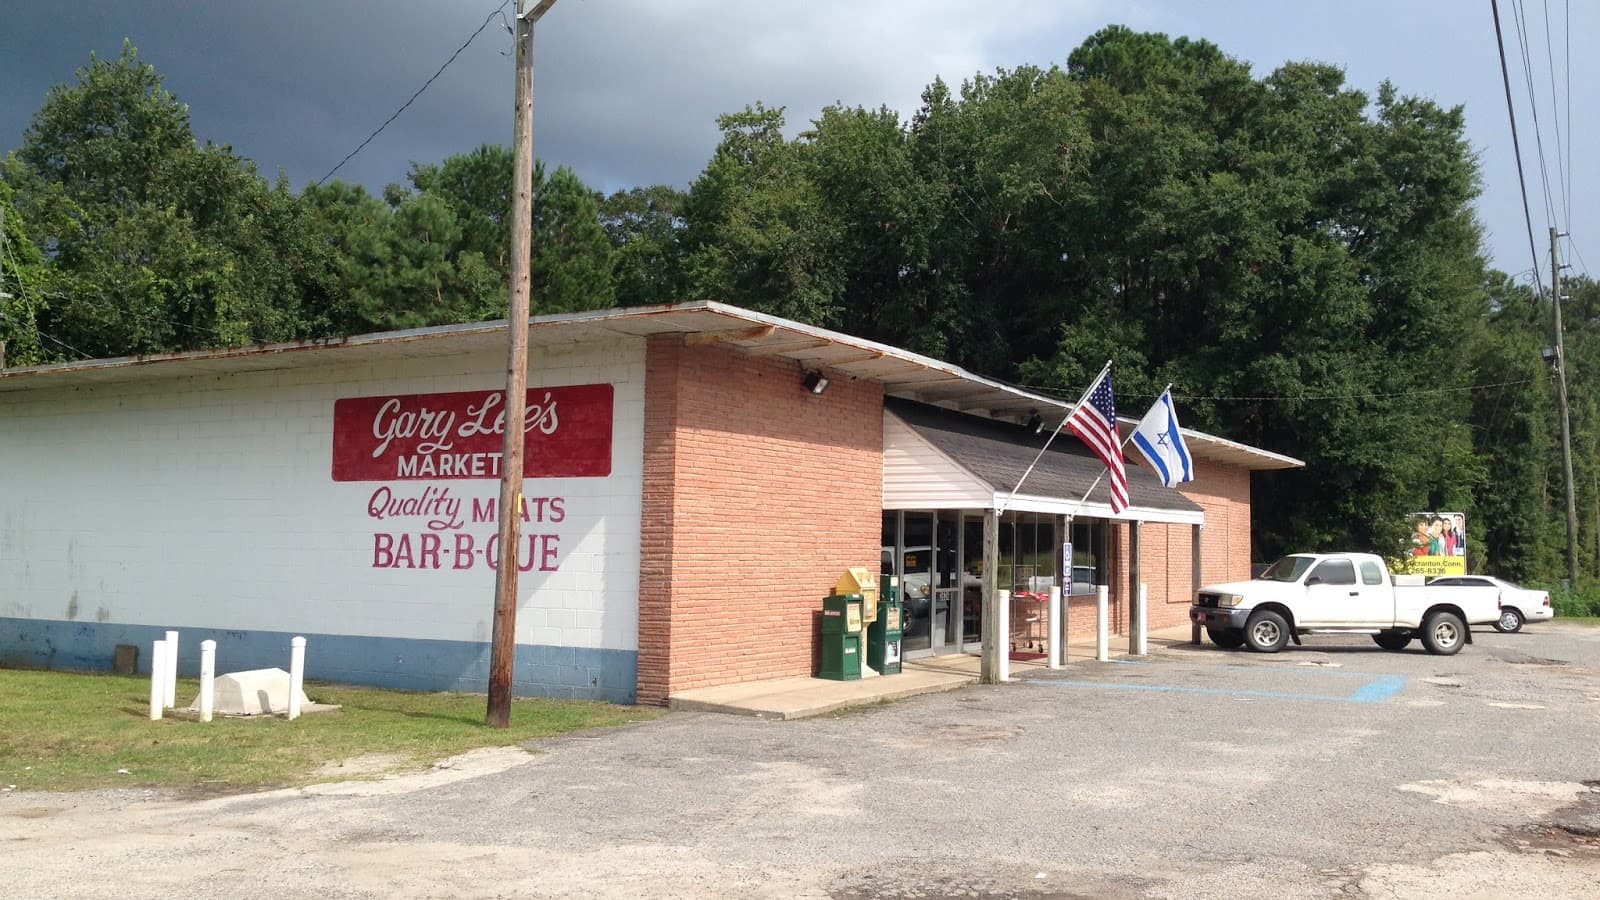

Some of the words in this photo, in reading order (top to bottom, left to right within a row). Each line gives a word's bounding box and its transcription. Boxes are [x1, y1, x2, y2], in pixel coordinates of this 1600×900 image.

[372, 398, 455, 458] Gary
[397, 453, 503, 477] MARKET
[368, 486, 464, 531] Quality
[472, 497, 566, 523] MATS
